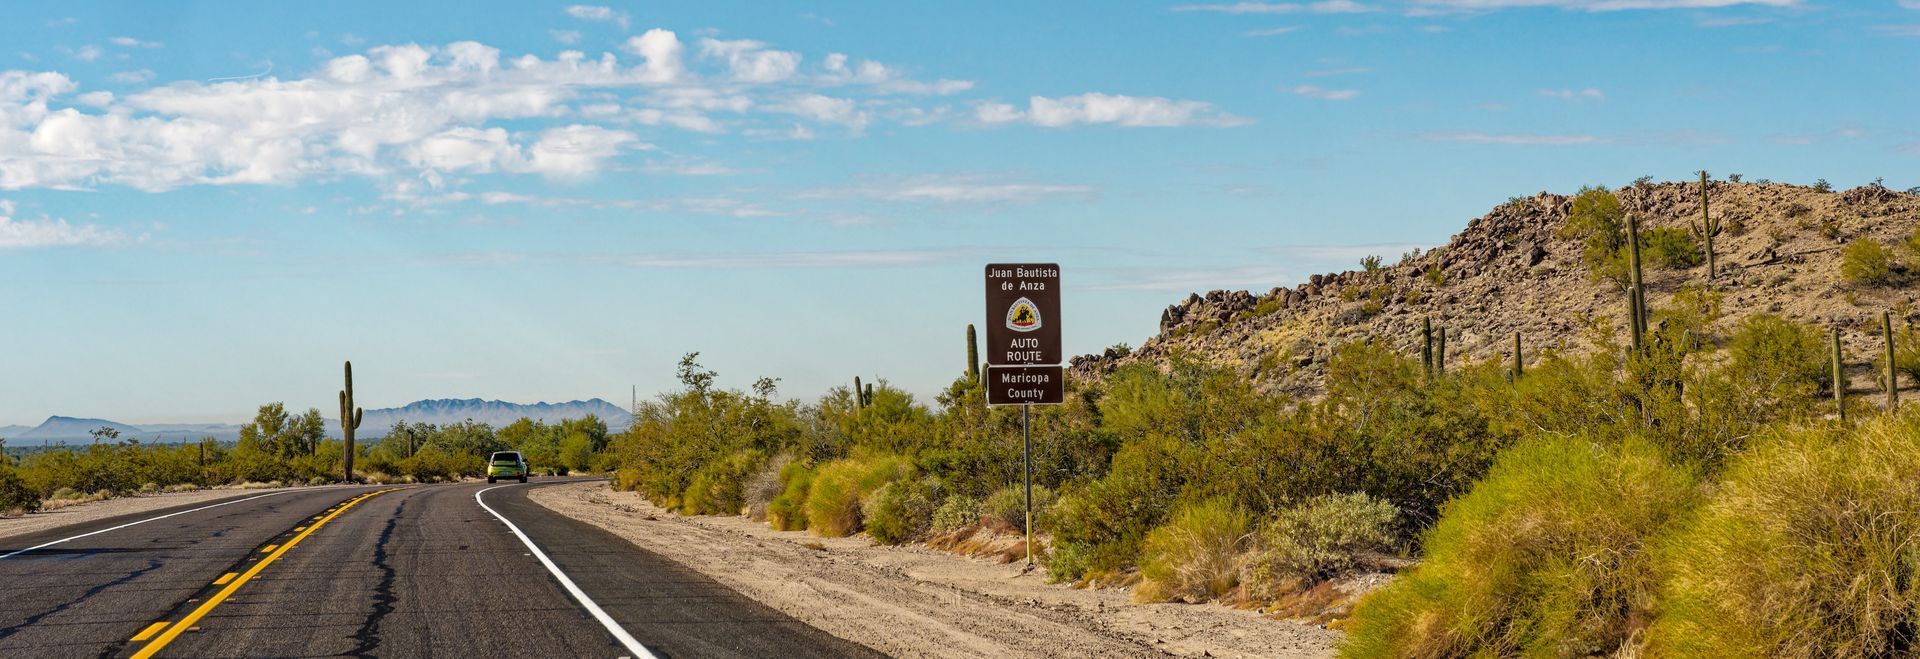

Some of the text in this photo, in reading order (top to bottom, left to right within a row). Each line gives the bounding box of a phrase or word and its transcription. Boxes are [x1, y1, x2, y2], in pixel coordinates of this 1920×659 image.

[989, 268, 1057, 277] Juan Bautista
[1002, 281, 1045, 290] de Anza
[1011, 339, 1038, 348] AUTO
[1007, 351, 1042, 361] ROUTE
[1002, 374, 1049, 384] Maricopa
[1008, 389, 1043, 399] County
